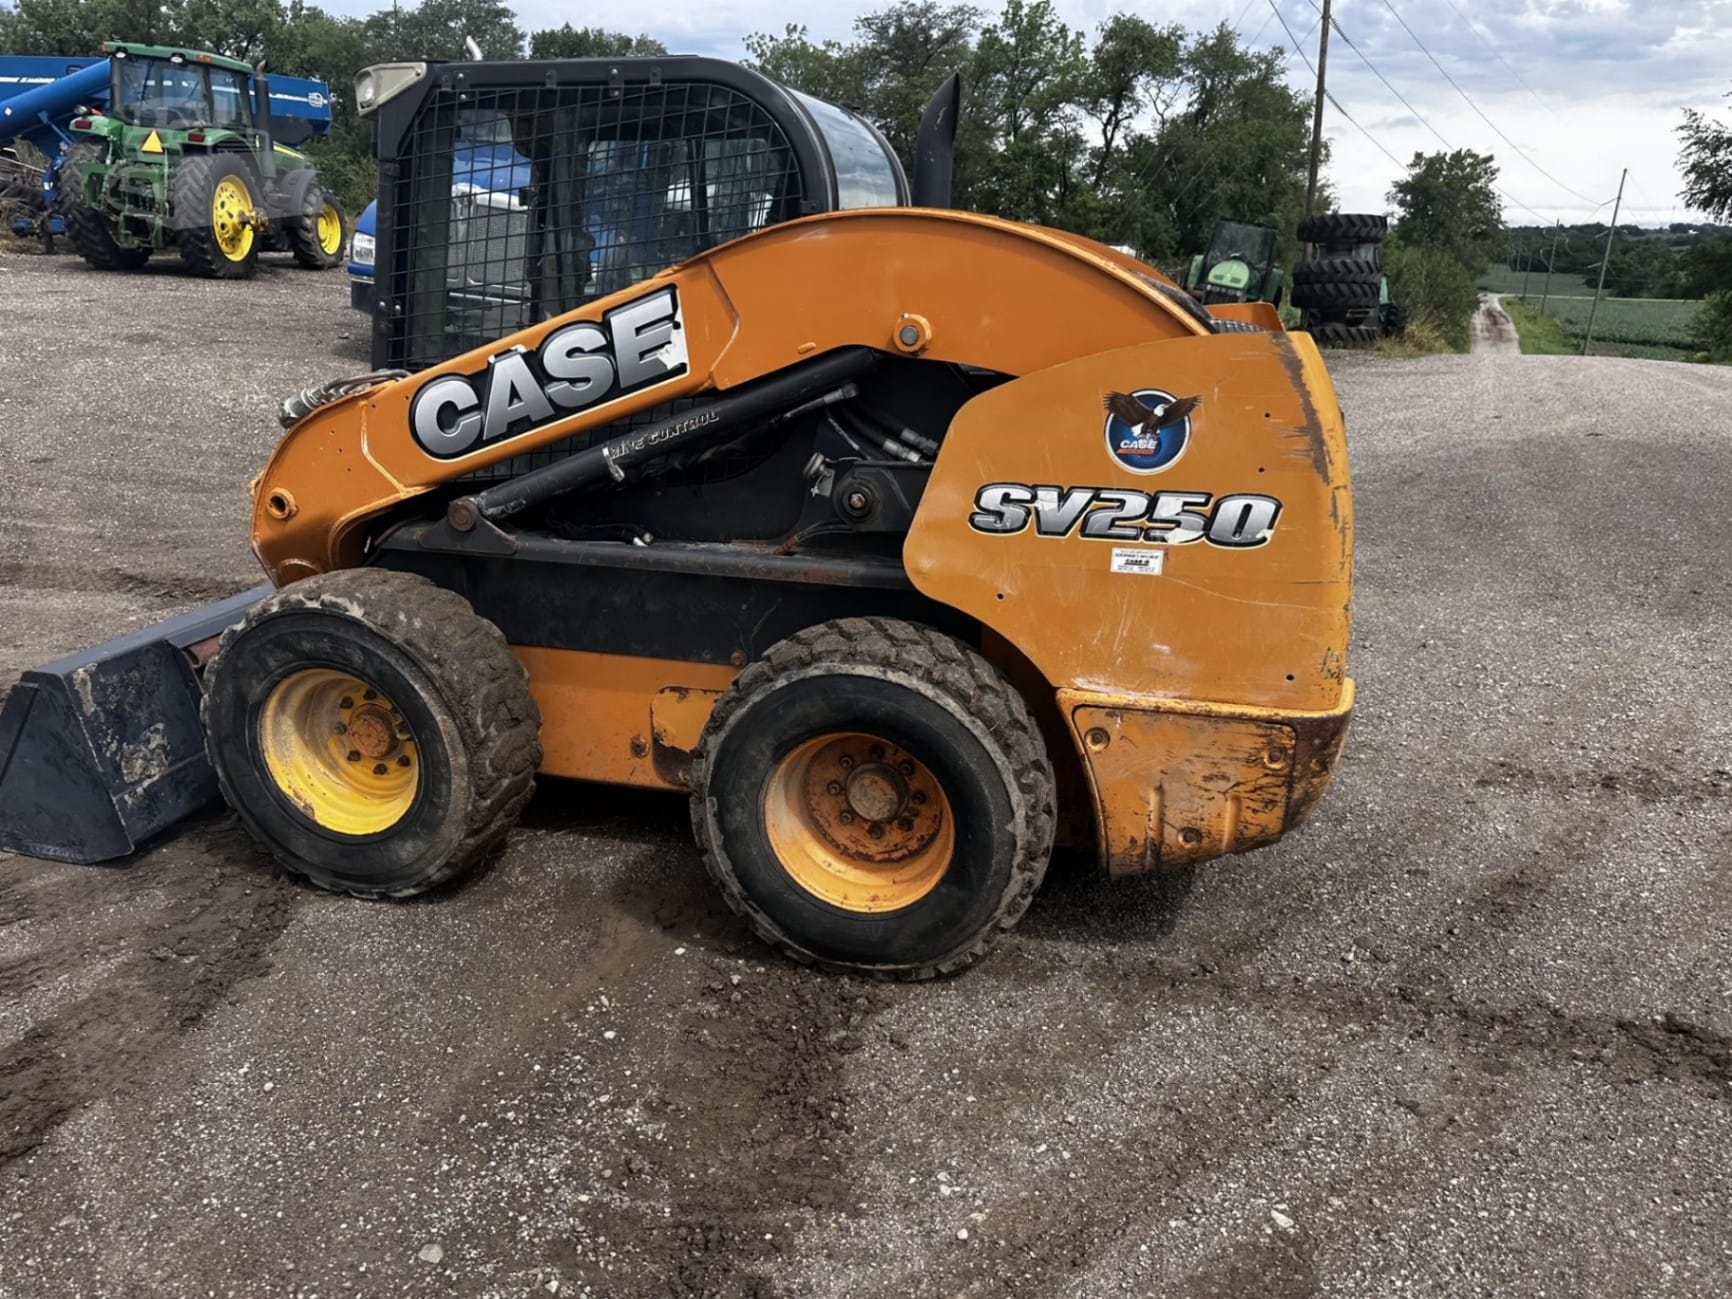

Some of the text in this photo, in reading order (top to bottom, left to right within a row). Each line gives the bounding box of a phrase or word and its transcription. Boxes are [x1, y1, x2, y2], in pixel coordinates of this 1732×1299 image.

[411, 288, 686, 457] CASE
[648, 409, 720, 446] CONTROL
[1119, 438, 1158, 450] CASE
[971, 483, 1282, 547] SV250
